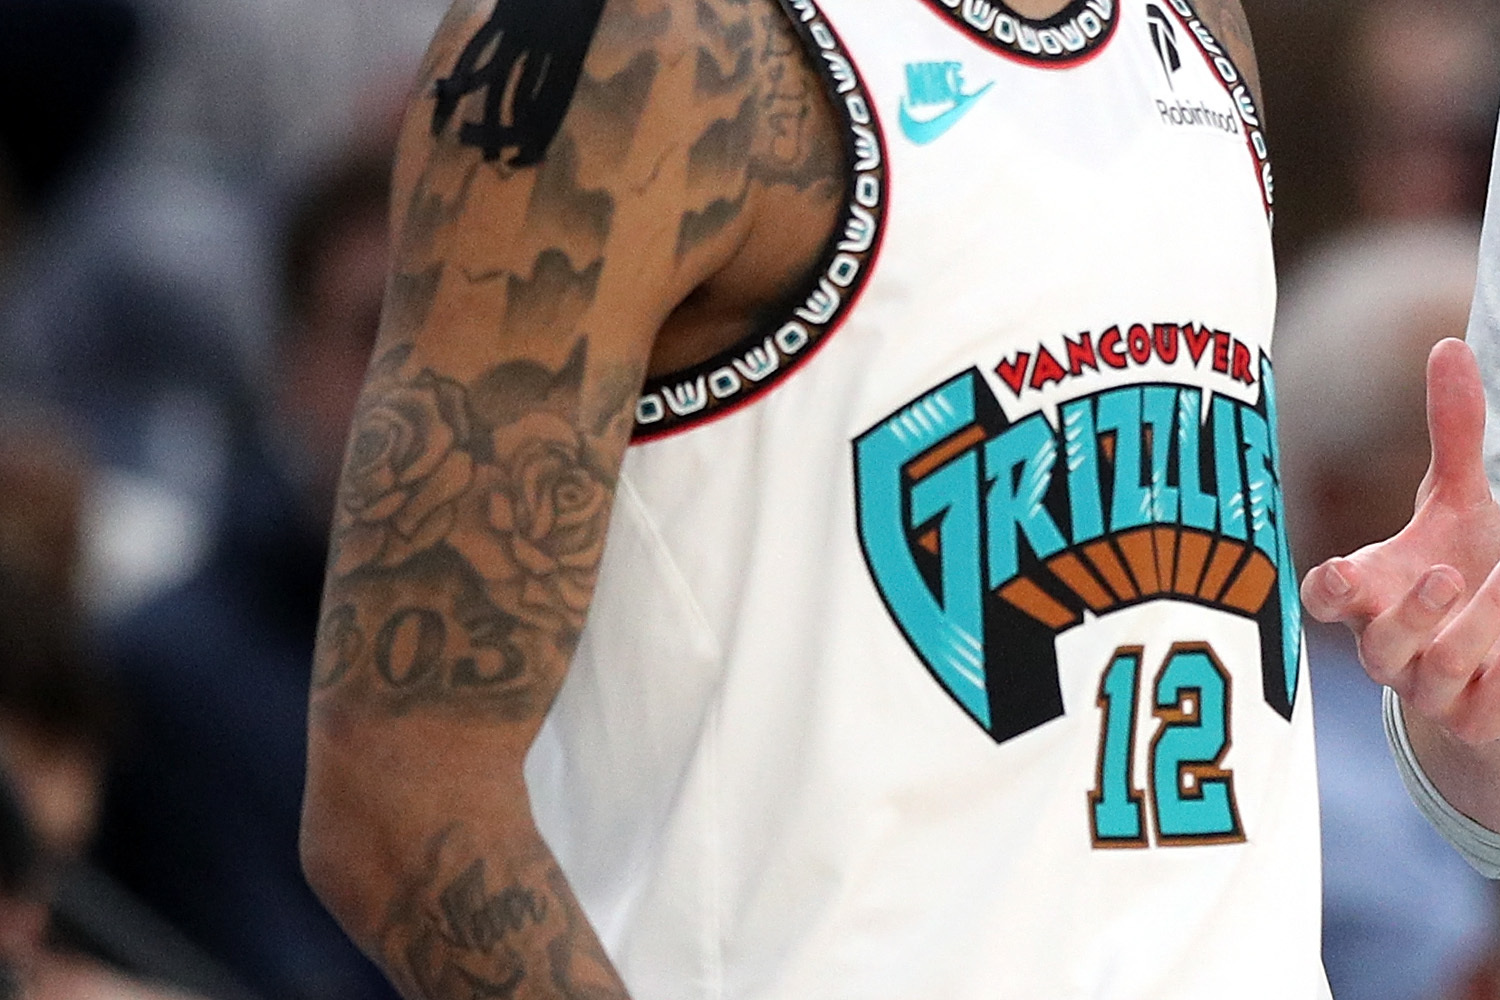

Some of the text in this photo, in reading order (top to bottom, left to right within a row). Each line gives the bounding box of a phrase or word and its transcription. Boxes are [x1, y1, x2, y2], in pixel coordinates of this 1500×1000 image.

[1155, 98, 1239, 134] Robinhood
[995, 323, 1255, 398] VANCOUVER
[1086, 641, 1247, 849] 12
